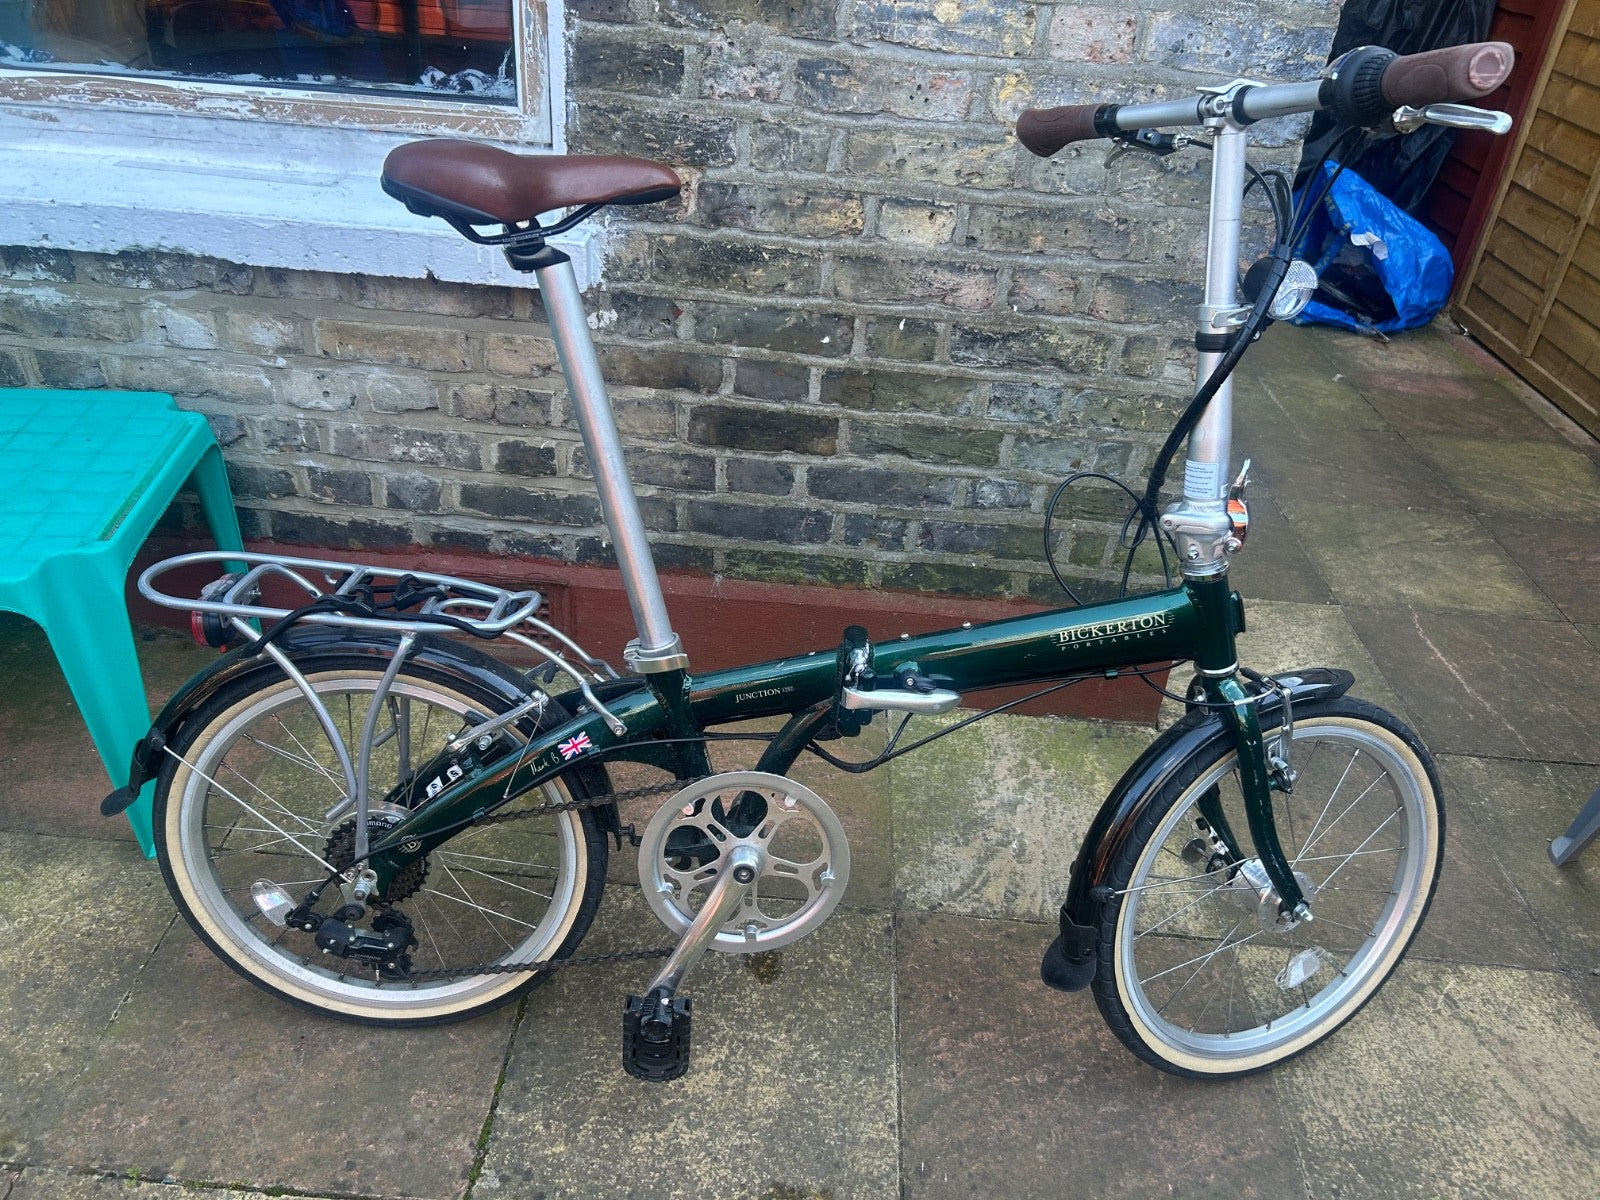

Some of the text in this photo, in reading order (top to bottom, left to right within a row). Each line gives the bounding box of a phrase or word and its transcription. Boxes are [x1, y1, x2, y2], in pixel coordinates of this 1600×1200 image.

[1058, 613, 1166, 643] BICKERTON
[1061, 628, 1167, 651] PORTABLES
[735, 687, 781, 703] JUNCTION
